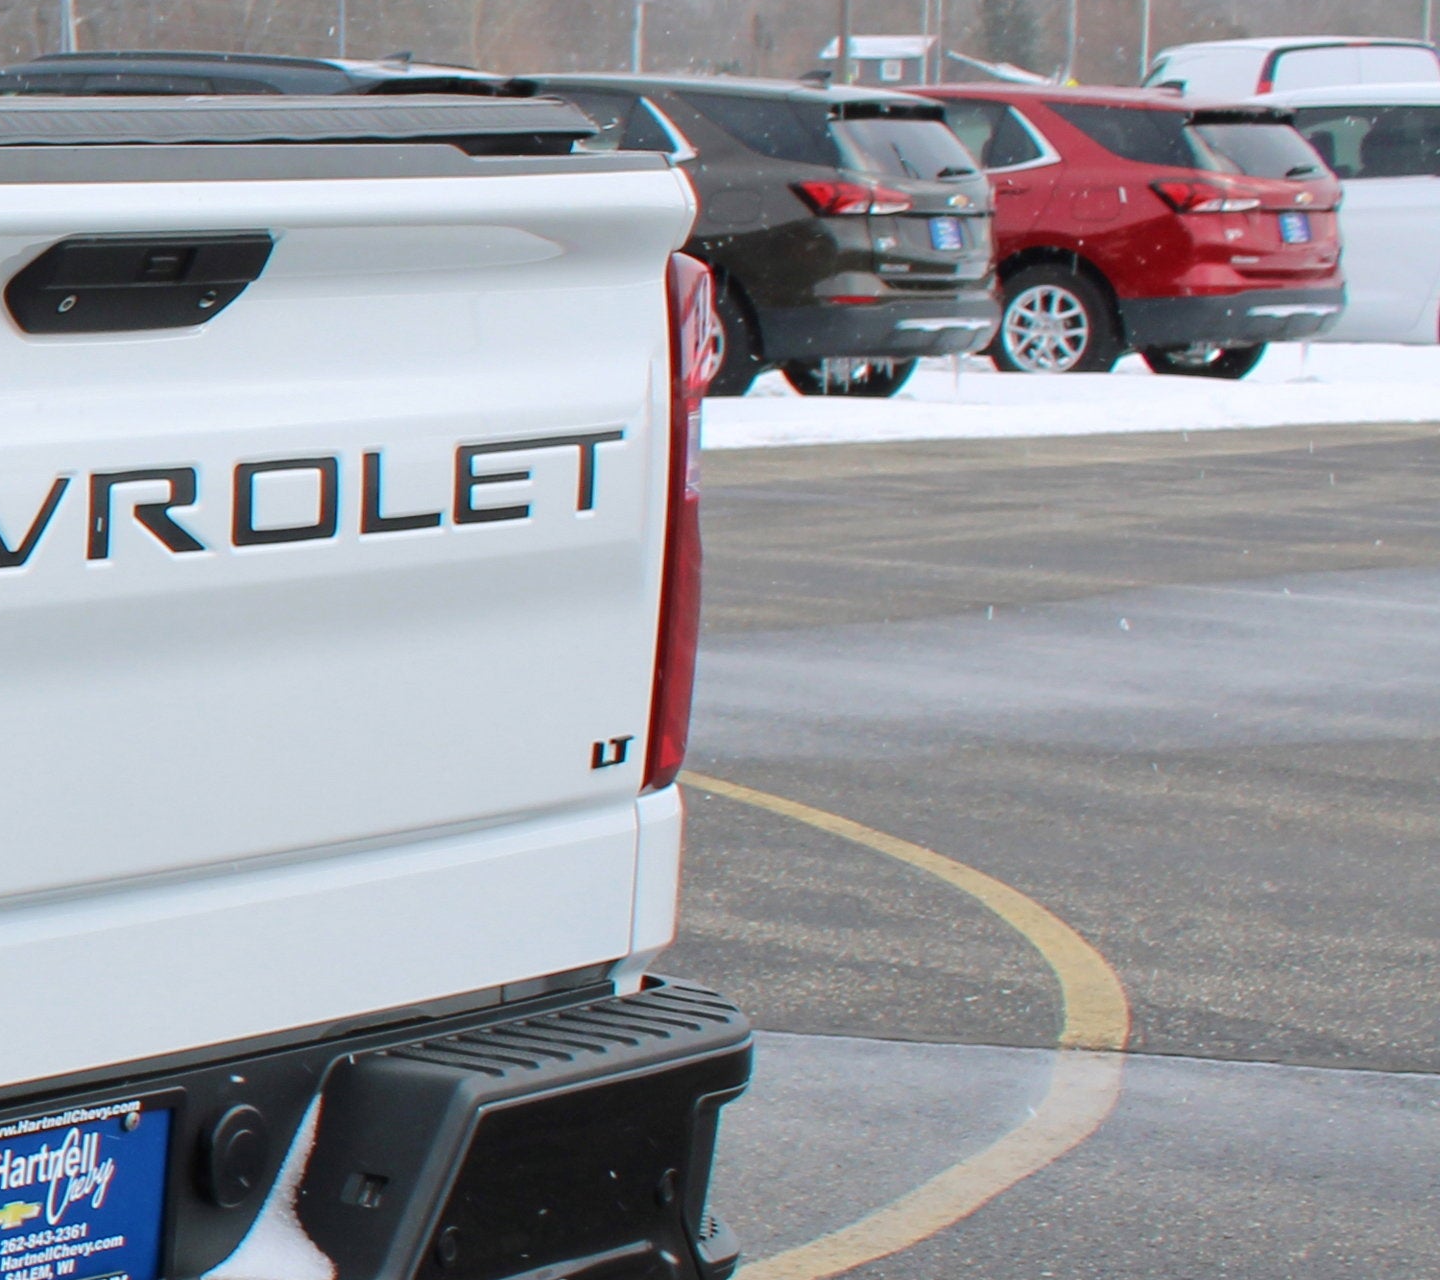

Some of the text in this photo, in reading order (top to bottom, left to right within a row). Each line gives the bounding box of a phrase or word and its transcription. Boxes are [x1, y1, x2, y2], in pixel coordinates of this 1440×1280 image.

[591, 735, 634, 769] LT
[0, 1222, 88, 1255] 262-843-2361
[1, 1235, 124, 1271] HartnellChevy.com
[56, 1259, 75, 1275] WI
